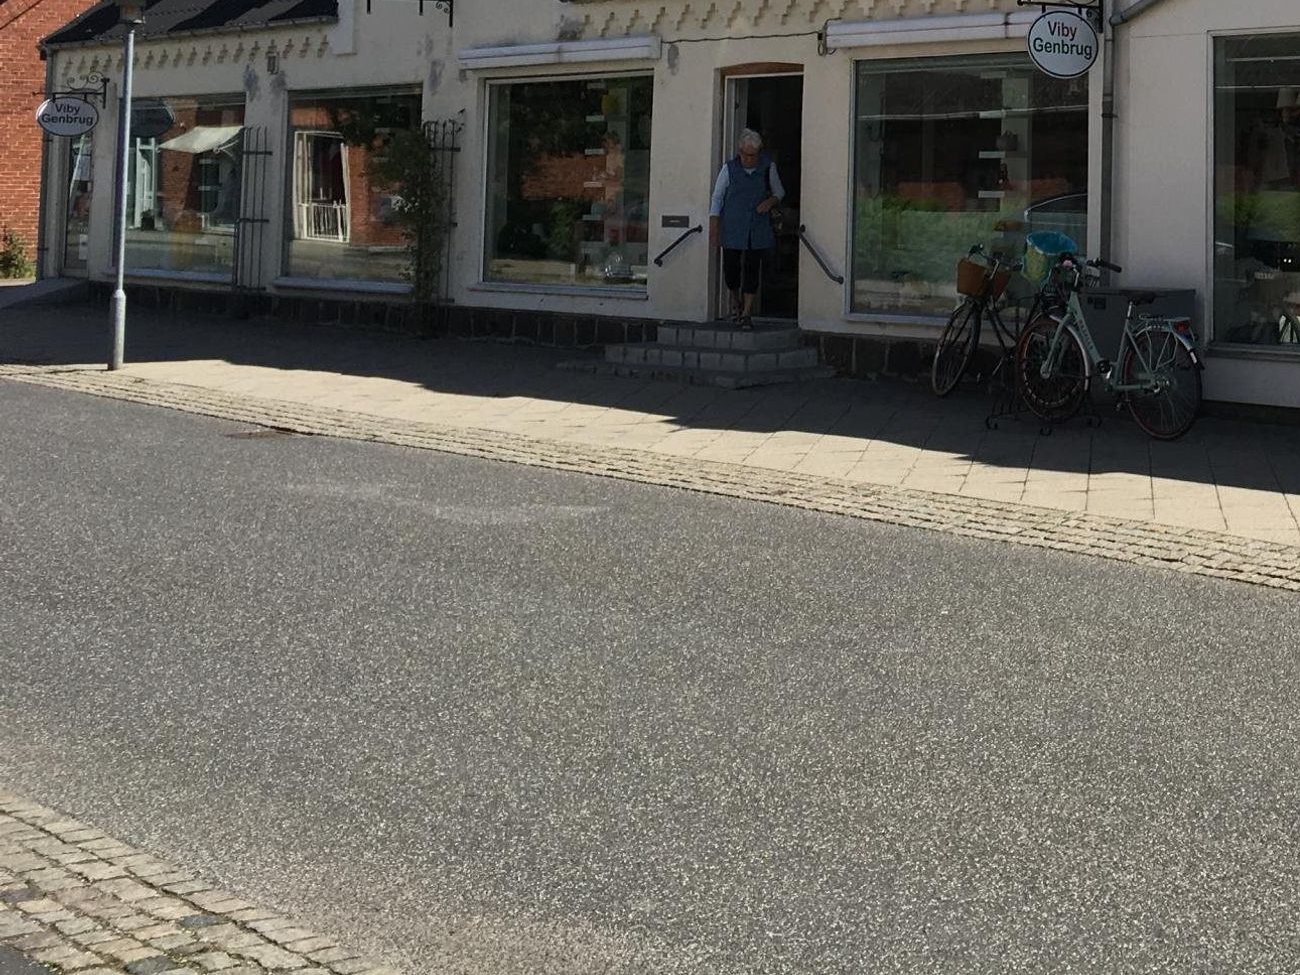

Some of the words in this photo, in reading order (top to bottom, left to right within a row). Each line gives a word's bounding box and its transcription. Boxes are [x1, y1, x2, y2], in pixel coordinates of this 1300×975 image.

[1047, 21, 1077, 41] Viby
[1033, 37, 1092, 60] Genbrug
[55, 103, 80, 115] Viby
[41, 113, 93, 126] Genbrug
